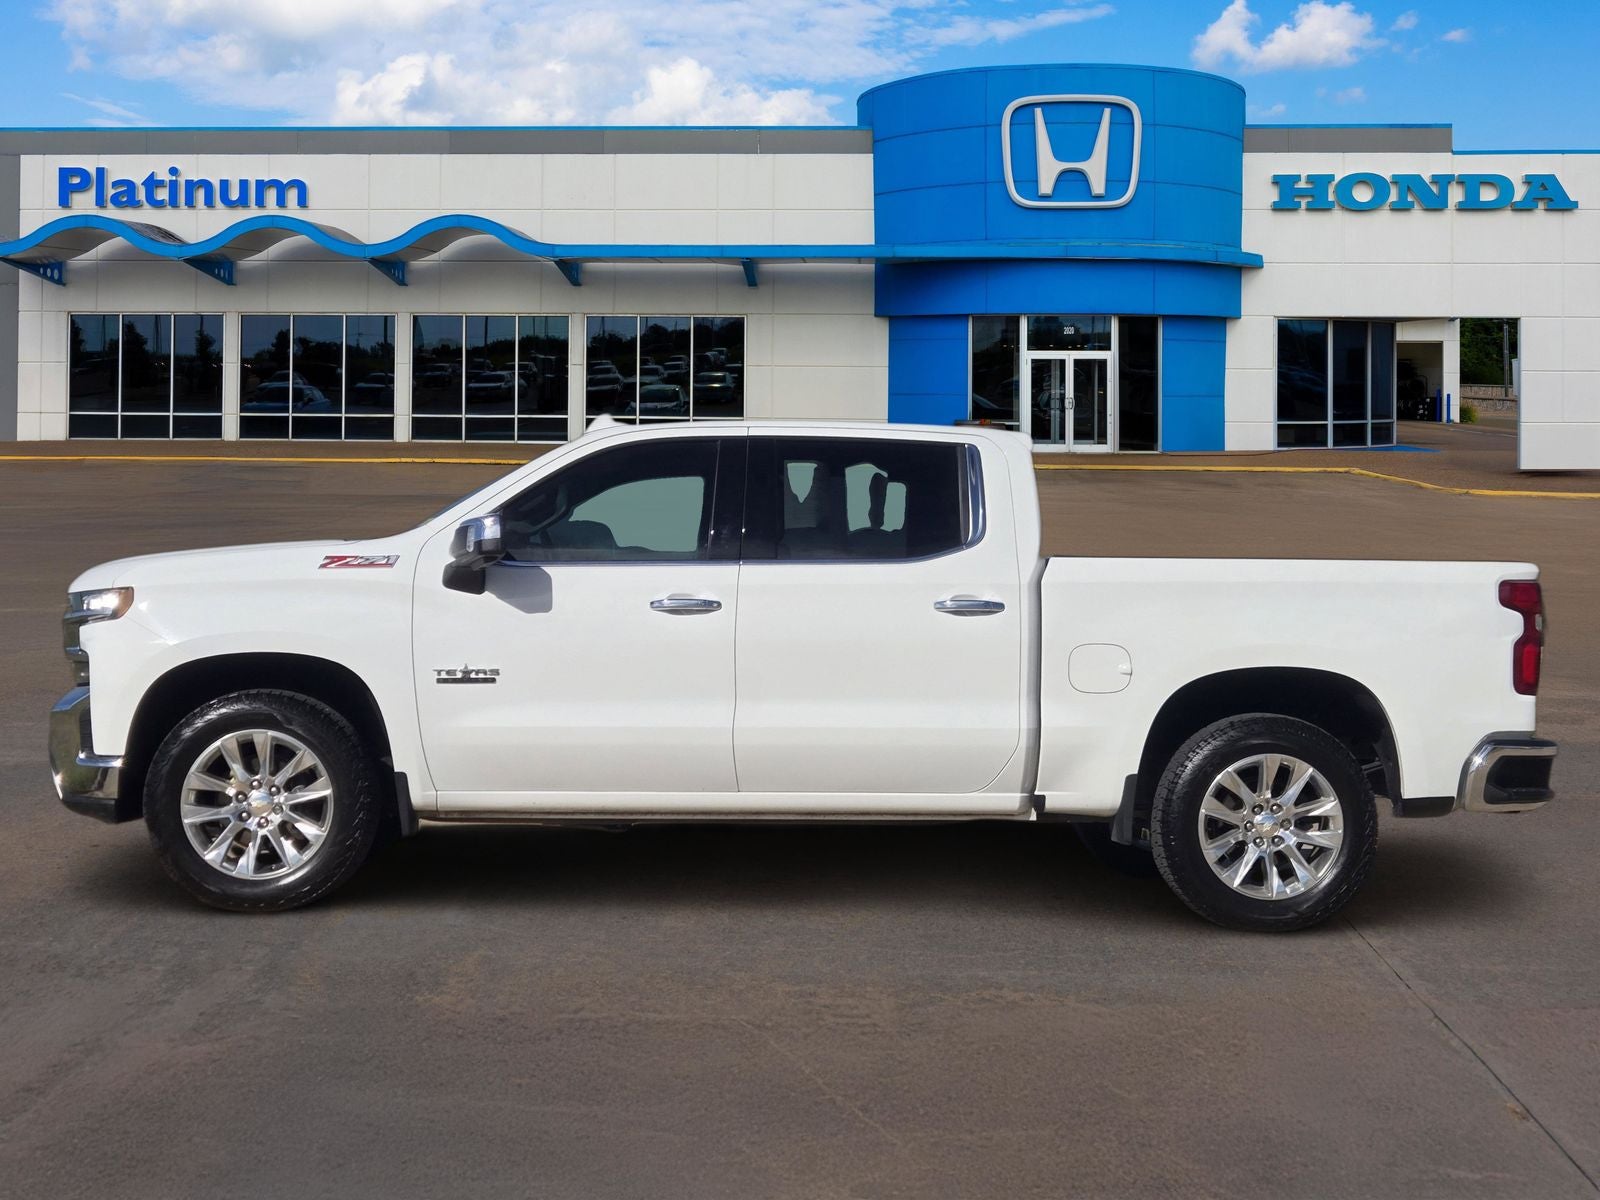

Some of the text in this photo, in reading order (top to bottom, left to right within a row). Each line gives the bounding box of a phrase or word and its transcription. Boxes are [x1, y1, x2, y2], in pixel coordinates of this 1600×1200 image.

[57, 166, 308, 208] Platinum
[1270, 172, 1579, 212] HONDA
[318, 555, 400, 569] Z71
